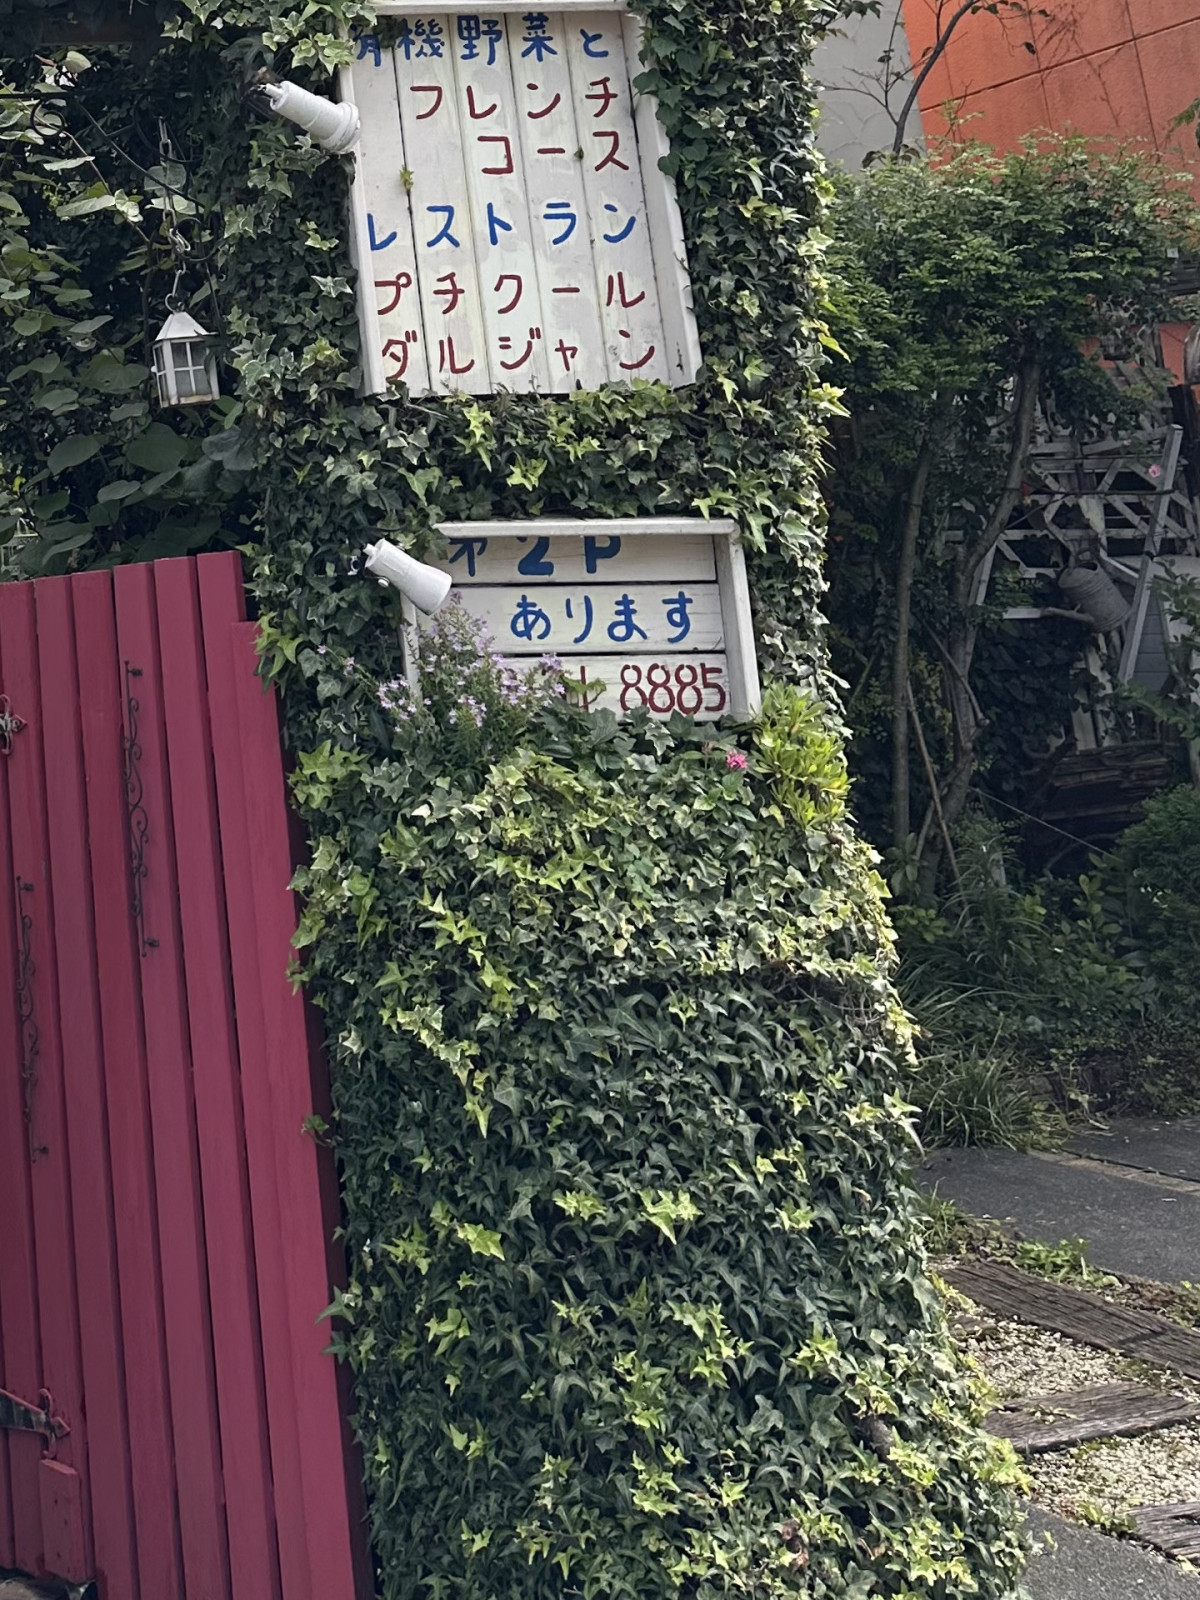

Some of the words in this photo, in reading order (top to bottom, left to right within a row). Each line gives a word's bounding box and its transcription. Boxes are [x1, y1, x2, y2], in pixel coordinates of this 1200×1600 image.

[409, 76, 618, 120] フレンチ
[477, 131, 630, 175] コース
[367, 202, 636, 252] レストラン
[374, 271, 645, 315] プチクール
[382, 327, 655, 381] ダルジャン
[510, 591, 693, 644] あります
[620, 662, 726, 715] 8885
